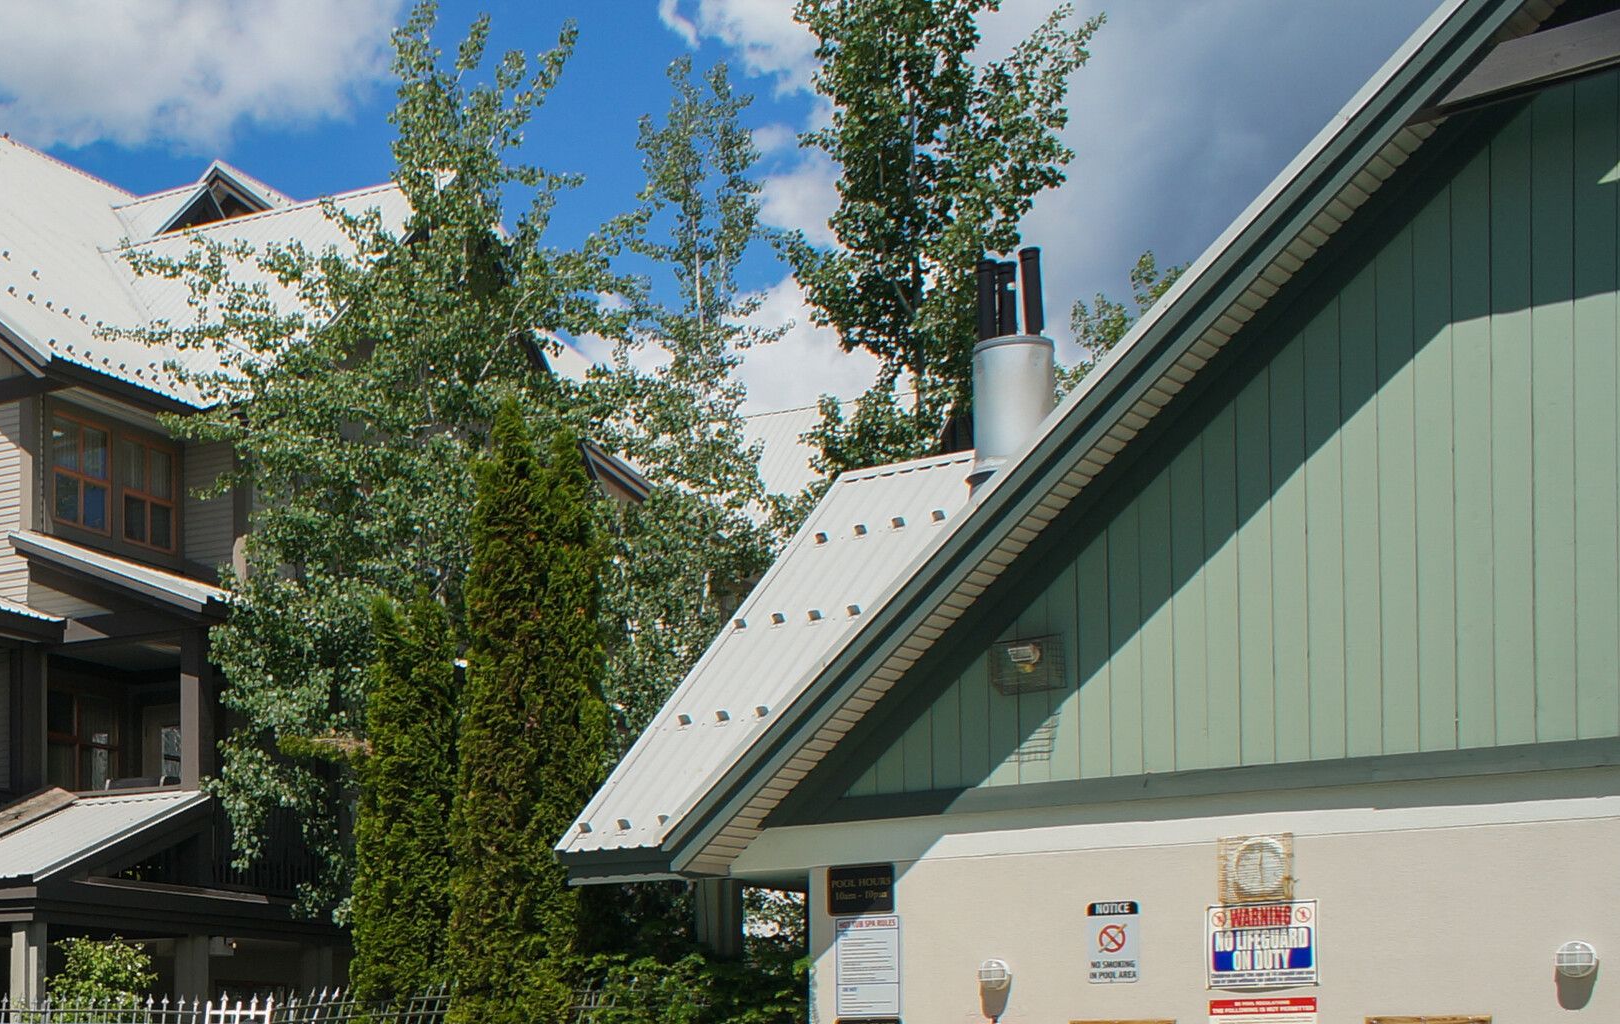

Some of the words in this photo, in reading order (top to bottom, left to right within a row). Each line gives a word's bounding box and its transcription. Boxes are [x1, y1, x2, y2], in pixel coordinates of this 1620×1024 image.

[1095, 902, 1131, 914] NOTICE
[1230, 905, 1292, 928] WARNING
[1214, 931, 1235, 952] NO
[1235, 927, 1309, 951] LIFEGUARD
[1102, 960, 1135, 968] SMOKING
[1233, 950, 1252, 971] ON
[1253, 948, 1291, 970] DUTY
[1098, 971, 1116, 979] POOL
[1118, 970, 1136, 978] AREA
